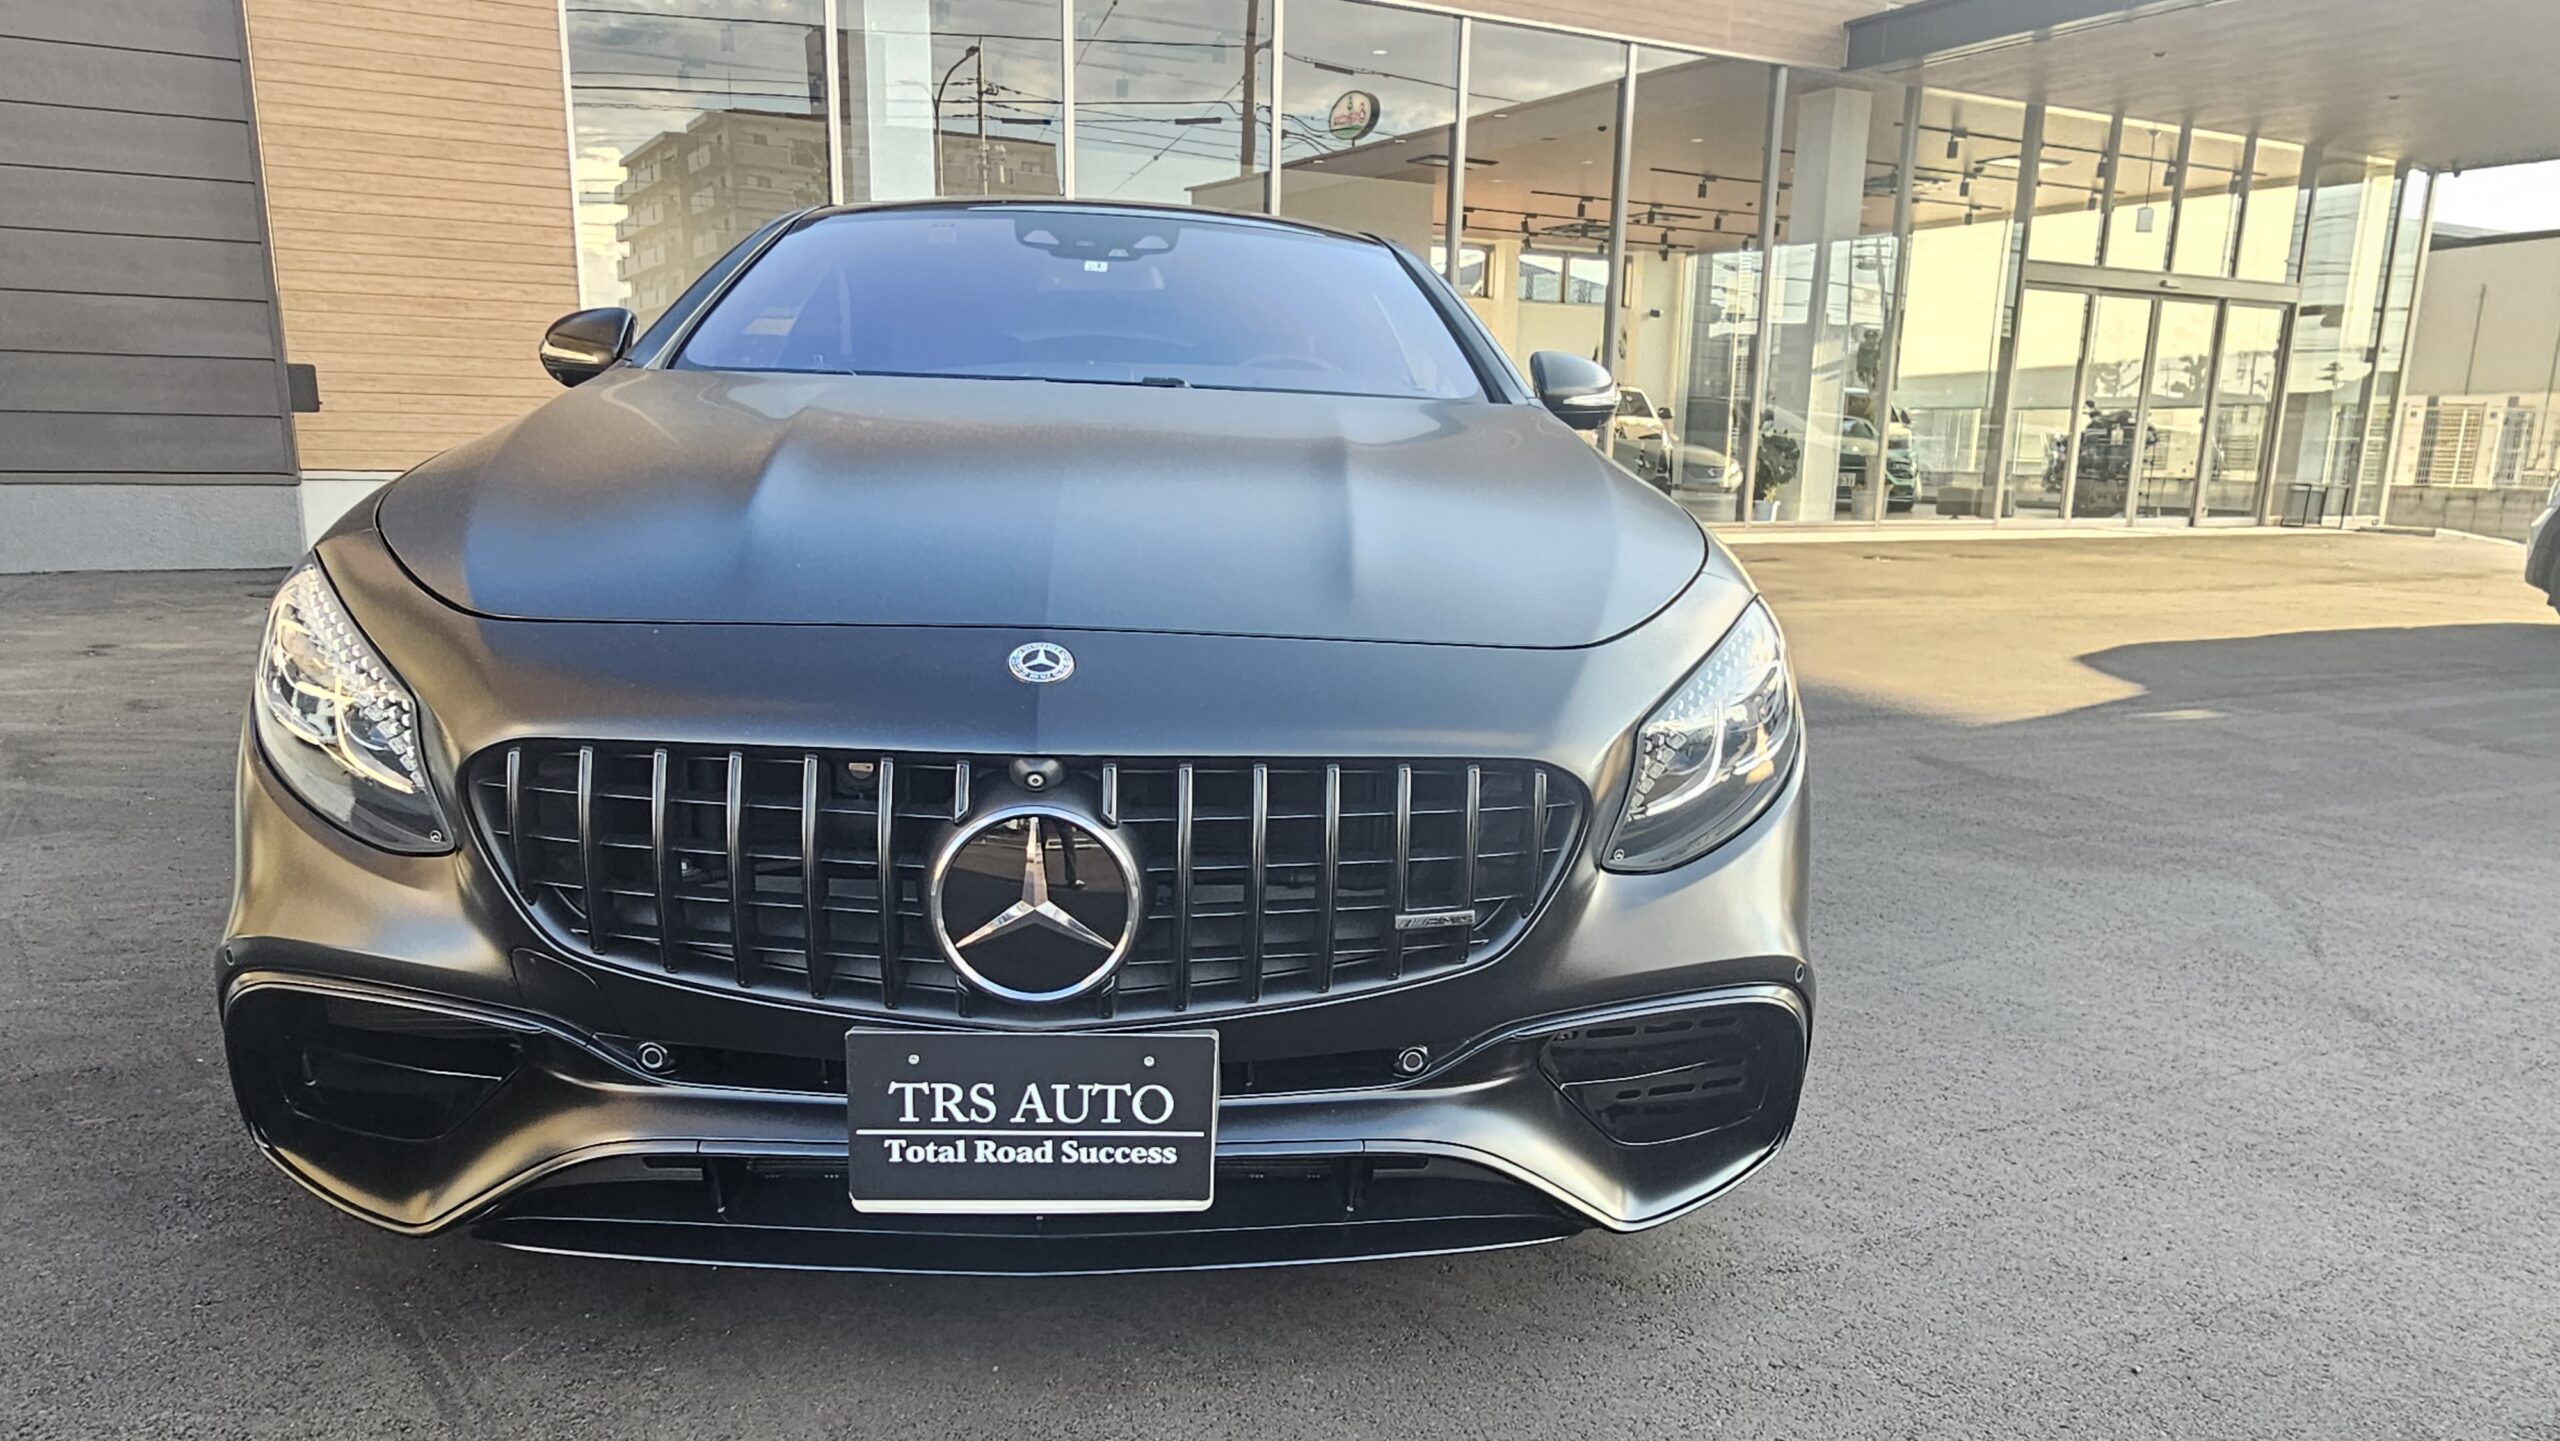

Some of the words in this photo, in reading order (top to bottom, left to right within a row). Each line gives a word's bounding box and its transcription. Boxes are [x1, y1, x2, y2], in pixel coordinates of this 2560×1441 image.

[887, 1080, 998, 1123] TRS
[1009, 1082, 1175, 1125] AUTO
[883, 1139, 967, 1164] Total
[974, 1139, 1054, 1164] Road
[1061, 1140, 1178, 1165] Success
